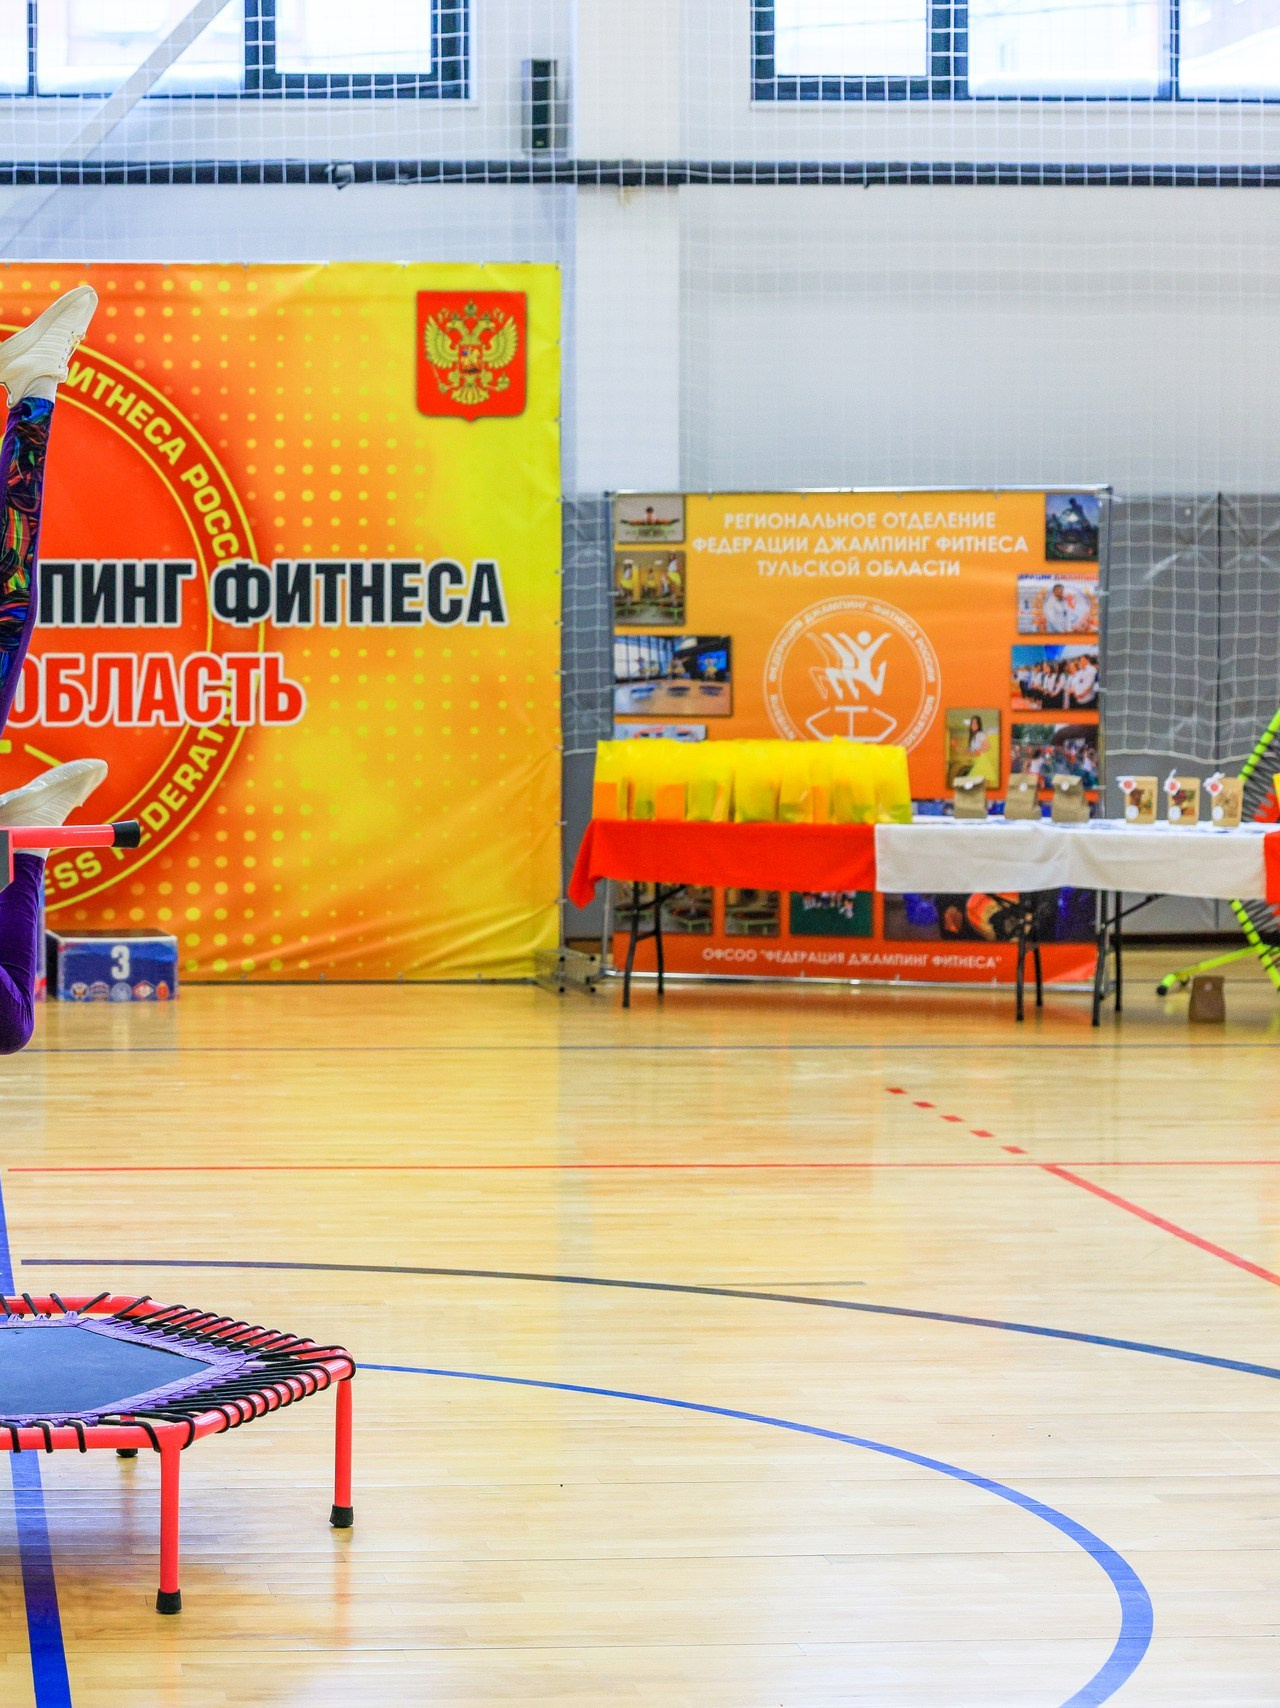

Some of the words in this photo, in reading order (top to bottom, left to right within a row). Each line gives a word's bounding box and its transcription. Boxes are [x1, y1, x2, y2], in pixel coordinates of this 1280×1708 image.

[66, 361, 187, 466] ИТНЕСА
[180, 463, 242, 560] РОСС
[724, 511, 877, 530] РЕГИОНАЛЬНОЕ
[881, 511, 996, 530] ОТДЕЛЕНИЕ
[691, 536, 809, 555] ФЕДЕРАЦИИ
[814, 535, 931, 555] ДЖАМПИНГ
[935, 535, 1029, 554] ФИТНЕСА
[757, 556, 860, 577] ТУЛЬСКОЙ
[866, 559, 961, 577] ОБЛАСТИ
[213, 558, 508, 627] ФИТНЕСА
[7, 651, 307, 728] ОБЛАСТЬ
[111, 944, 131, 980] 3
